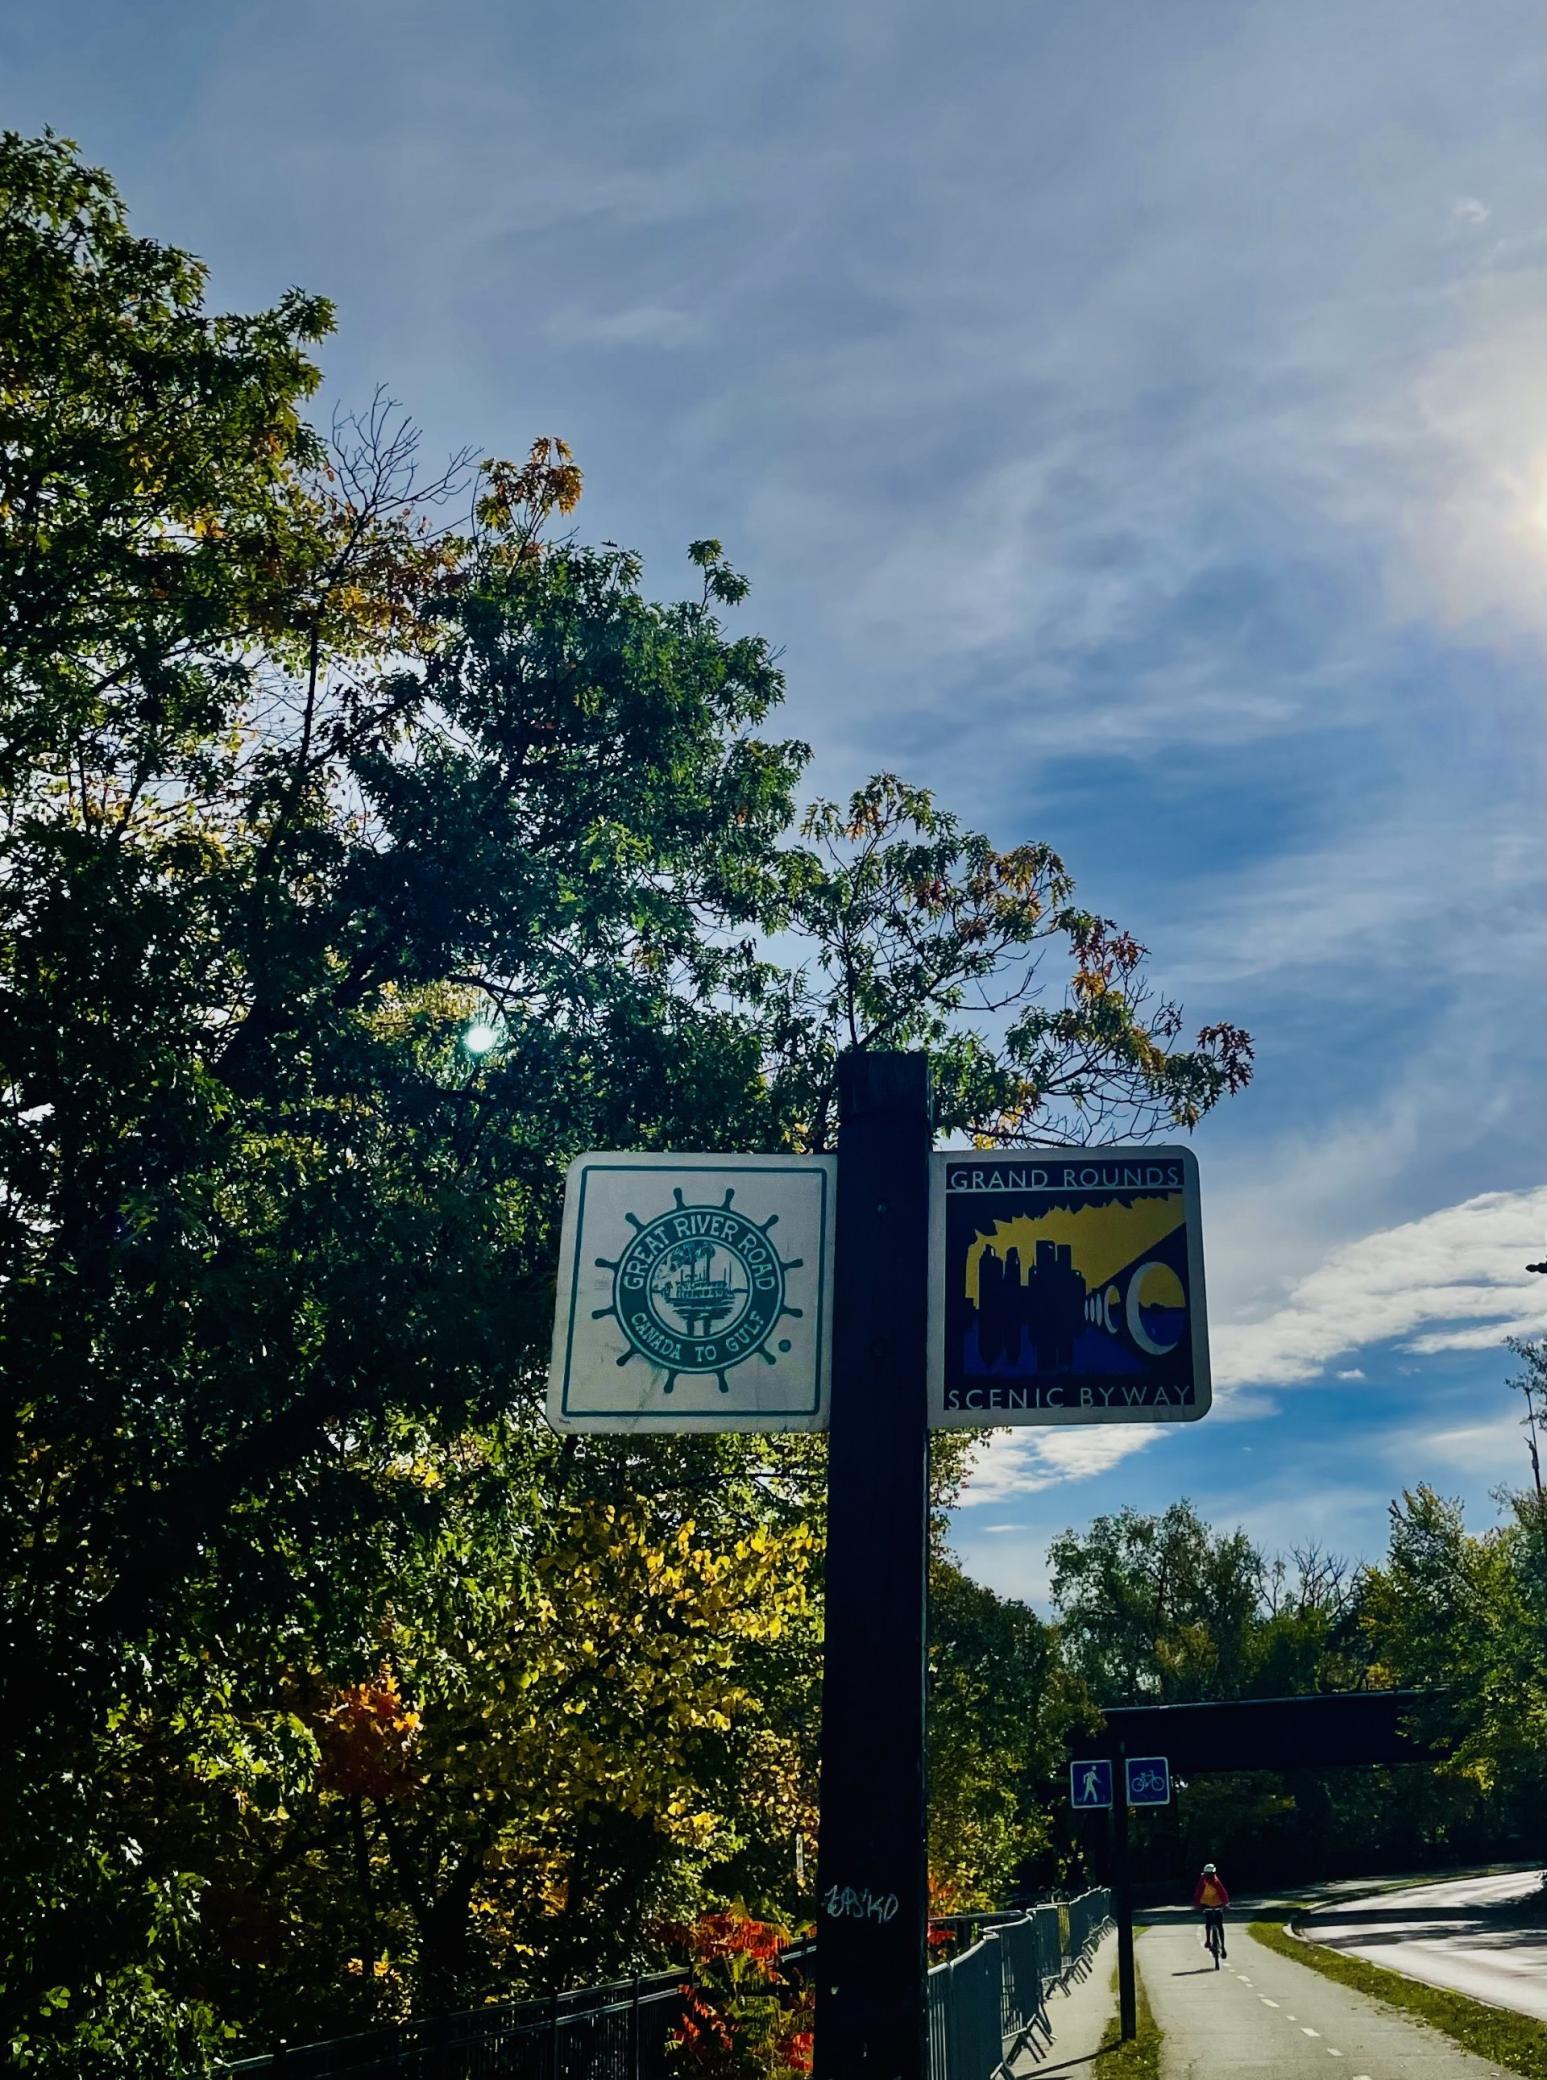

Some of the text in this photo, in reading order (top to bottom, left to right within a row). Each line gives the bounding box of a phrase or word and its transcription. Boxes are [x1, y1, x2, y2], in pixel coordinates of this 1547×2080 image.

[951, 1166, 1178, 1190] GRAND ROUNDS
[623, 1214, 775, 1290] GREAT RIVER ROAD
[631, 1311, 764, 1362] CANADA TO GULF
[948, 1387, 1064, 1410] SCENIC
